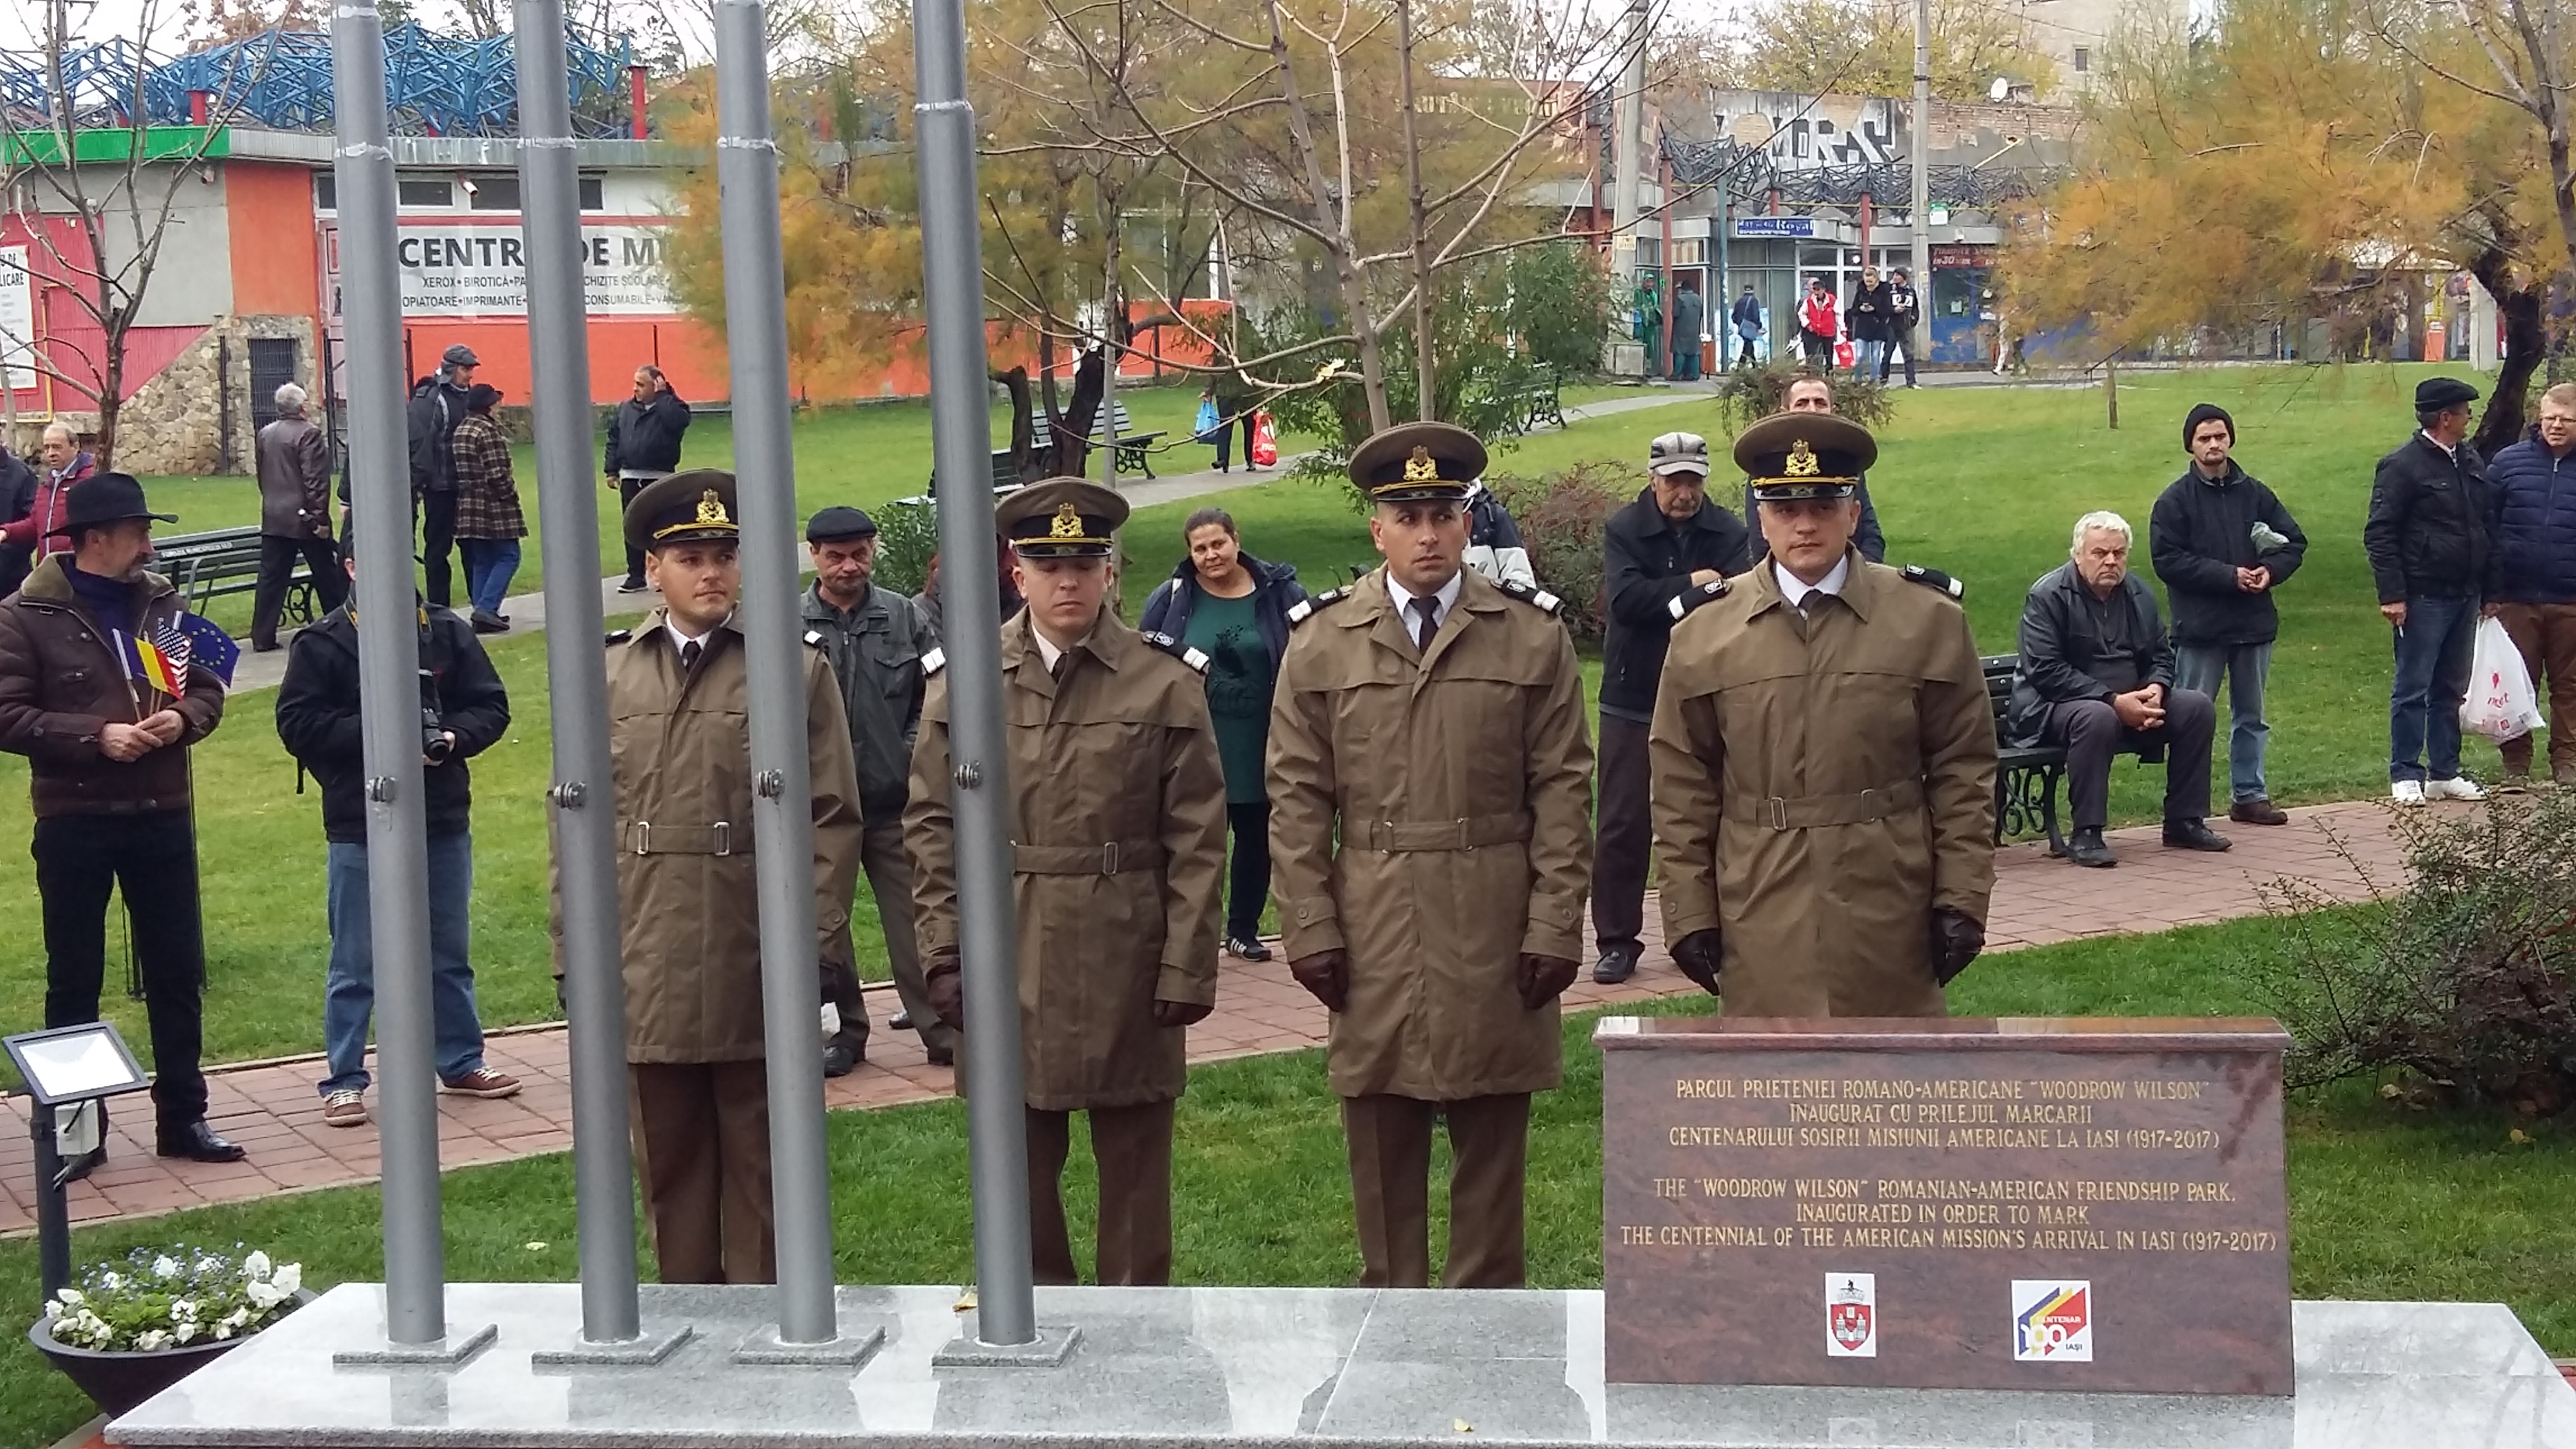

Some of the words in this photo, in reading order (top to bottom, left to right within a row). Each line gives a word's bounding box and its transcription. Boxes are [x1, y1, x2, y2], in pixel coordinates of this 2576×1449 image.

[399, 238, 526, 267] CENTR
[582, 238, 610, 266] E
[422, 277, 456, 287] XEROX
[402, 296, 457, 307] OPIATOARE
[463, 296, 522, 306] IMPRIMANTE
[1677, 1079, 1735, 1098] PARCUL
[1744, 1080, 1835, 1098] PRIETENIEI
[1843, 1080, 2023, 1099] ROMANO-AMERICANE
[1789, 1103, 1883, 1123] INAUGURAT
[1890, 1103, 1911, 1123] CU
[1918, 1104, 1998, 1123] PRILEJUL
[2006, 1105, 2092, 1124] MARCARII
[1669, 1126, 1793, 1146] CENTENARULUI
[1800, 1128, 1860, 1147] SOSIRII
[1867, 1128, 1939, 1148] MISIUNII
[1946, 1128, 2049, 1148] AMERICANE
[2057, 1129, 2079, 1148] LA
[2087, 1129, 2119, 1148] IASI
[2127, 1129, 2219, 1149] (1917-2017)
[1653, 1178, 1687, 1197] THE
[1878, 1179, 2069, 1200] ROMANIAN-AMERICAN
[2077, 1181, 2180, 1201] FRIENDSHIP
[1796, 1203, 1912, 1223] INAUGURATED
[1918, 1204, 1936, 1223] IN
[1943, 1204, 2000, 1224] ORDER
[2007, 1205, 2030, 1224] TO
[2038, 1205, 2090, 1225] MARK
[1621, 1226, 1654, 1245] THE
[1661, 1226, 1768, 1246] CENTENNIAL
[1774, 1227, 1793, 1246] OF
[1800, 1227, 1835, 1247] THE
[1842, 1227, 1934, 1247] AMERICAN
[2032, 1230, 2109, 1250] ARRIVAL
[2117, 1231, 2134, 1250] IN
[2142, 1231, 2175, 1251] IASI
[2182, 1231, 2276, 1251] (1917-2017)
[2020, 1324, 2067, 1349] 100
